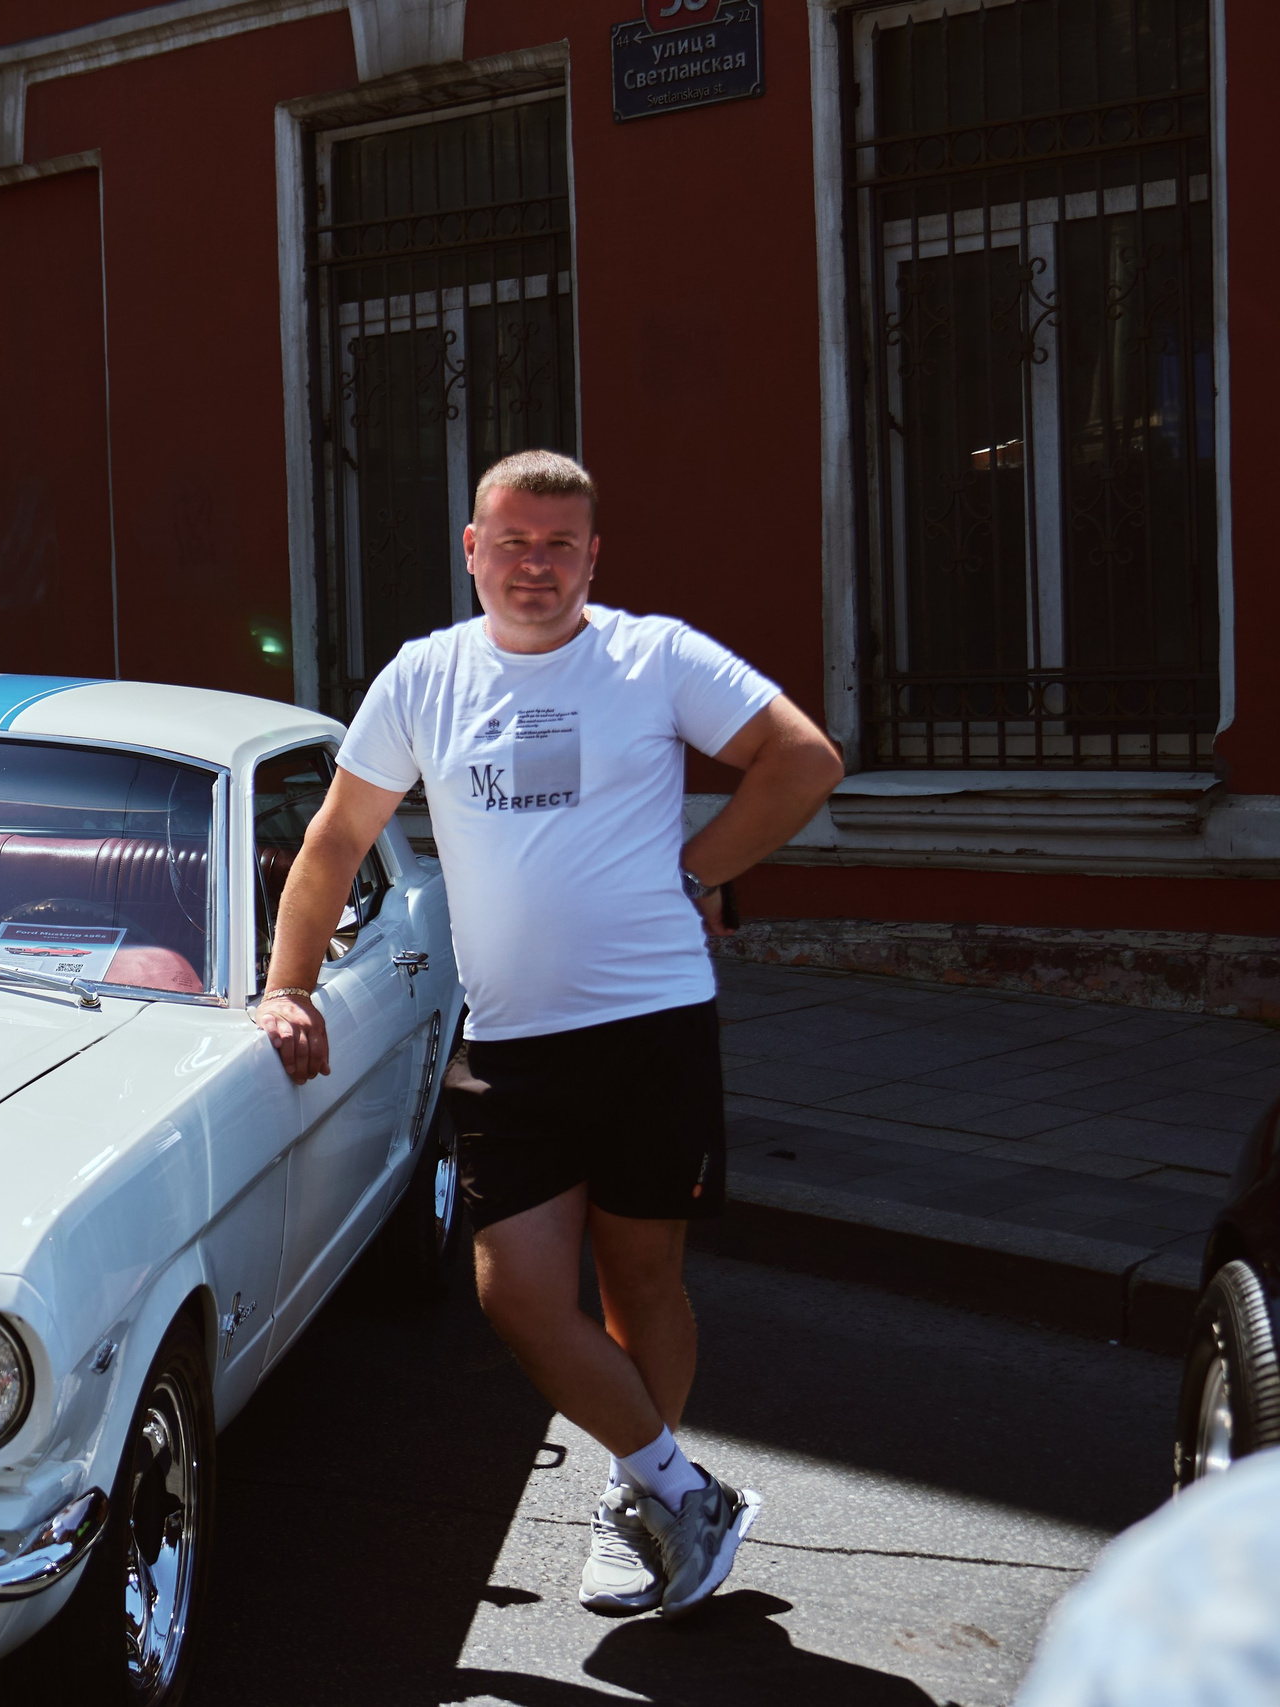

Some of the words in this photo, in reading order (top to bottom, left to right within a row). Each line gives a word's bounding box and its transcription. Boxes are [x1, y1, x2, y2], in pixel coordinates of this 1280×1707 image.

[738, 9, 751, 23] 22
[616, 35, 630, 48] 44
[651, 32, 716, 65] улица
[623, 51, 746, 90] Светланская
[646, 87, 710, 108] Svetlanskaya
[485, 791, 573, 811] PERFECT
